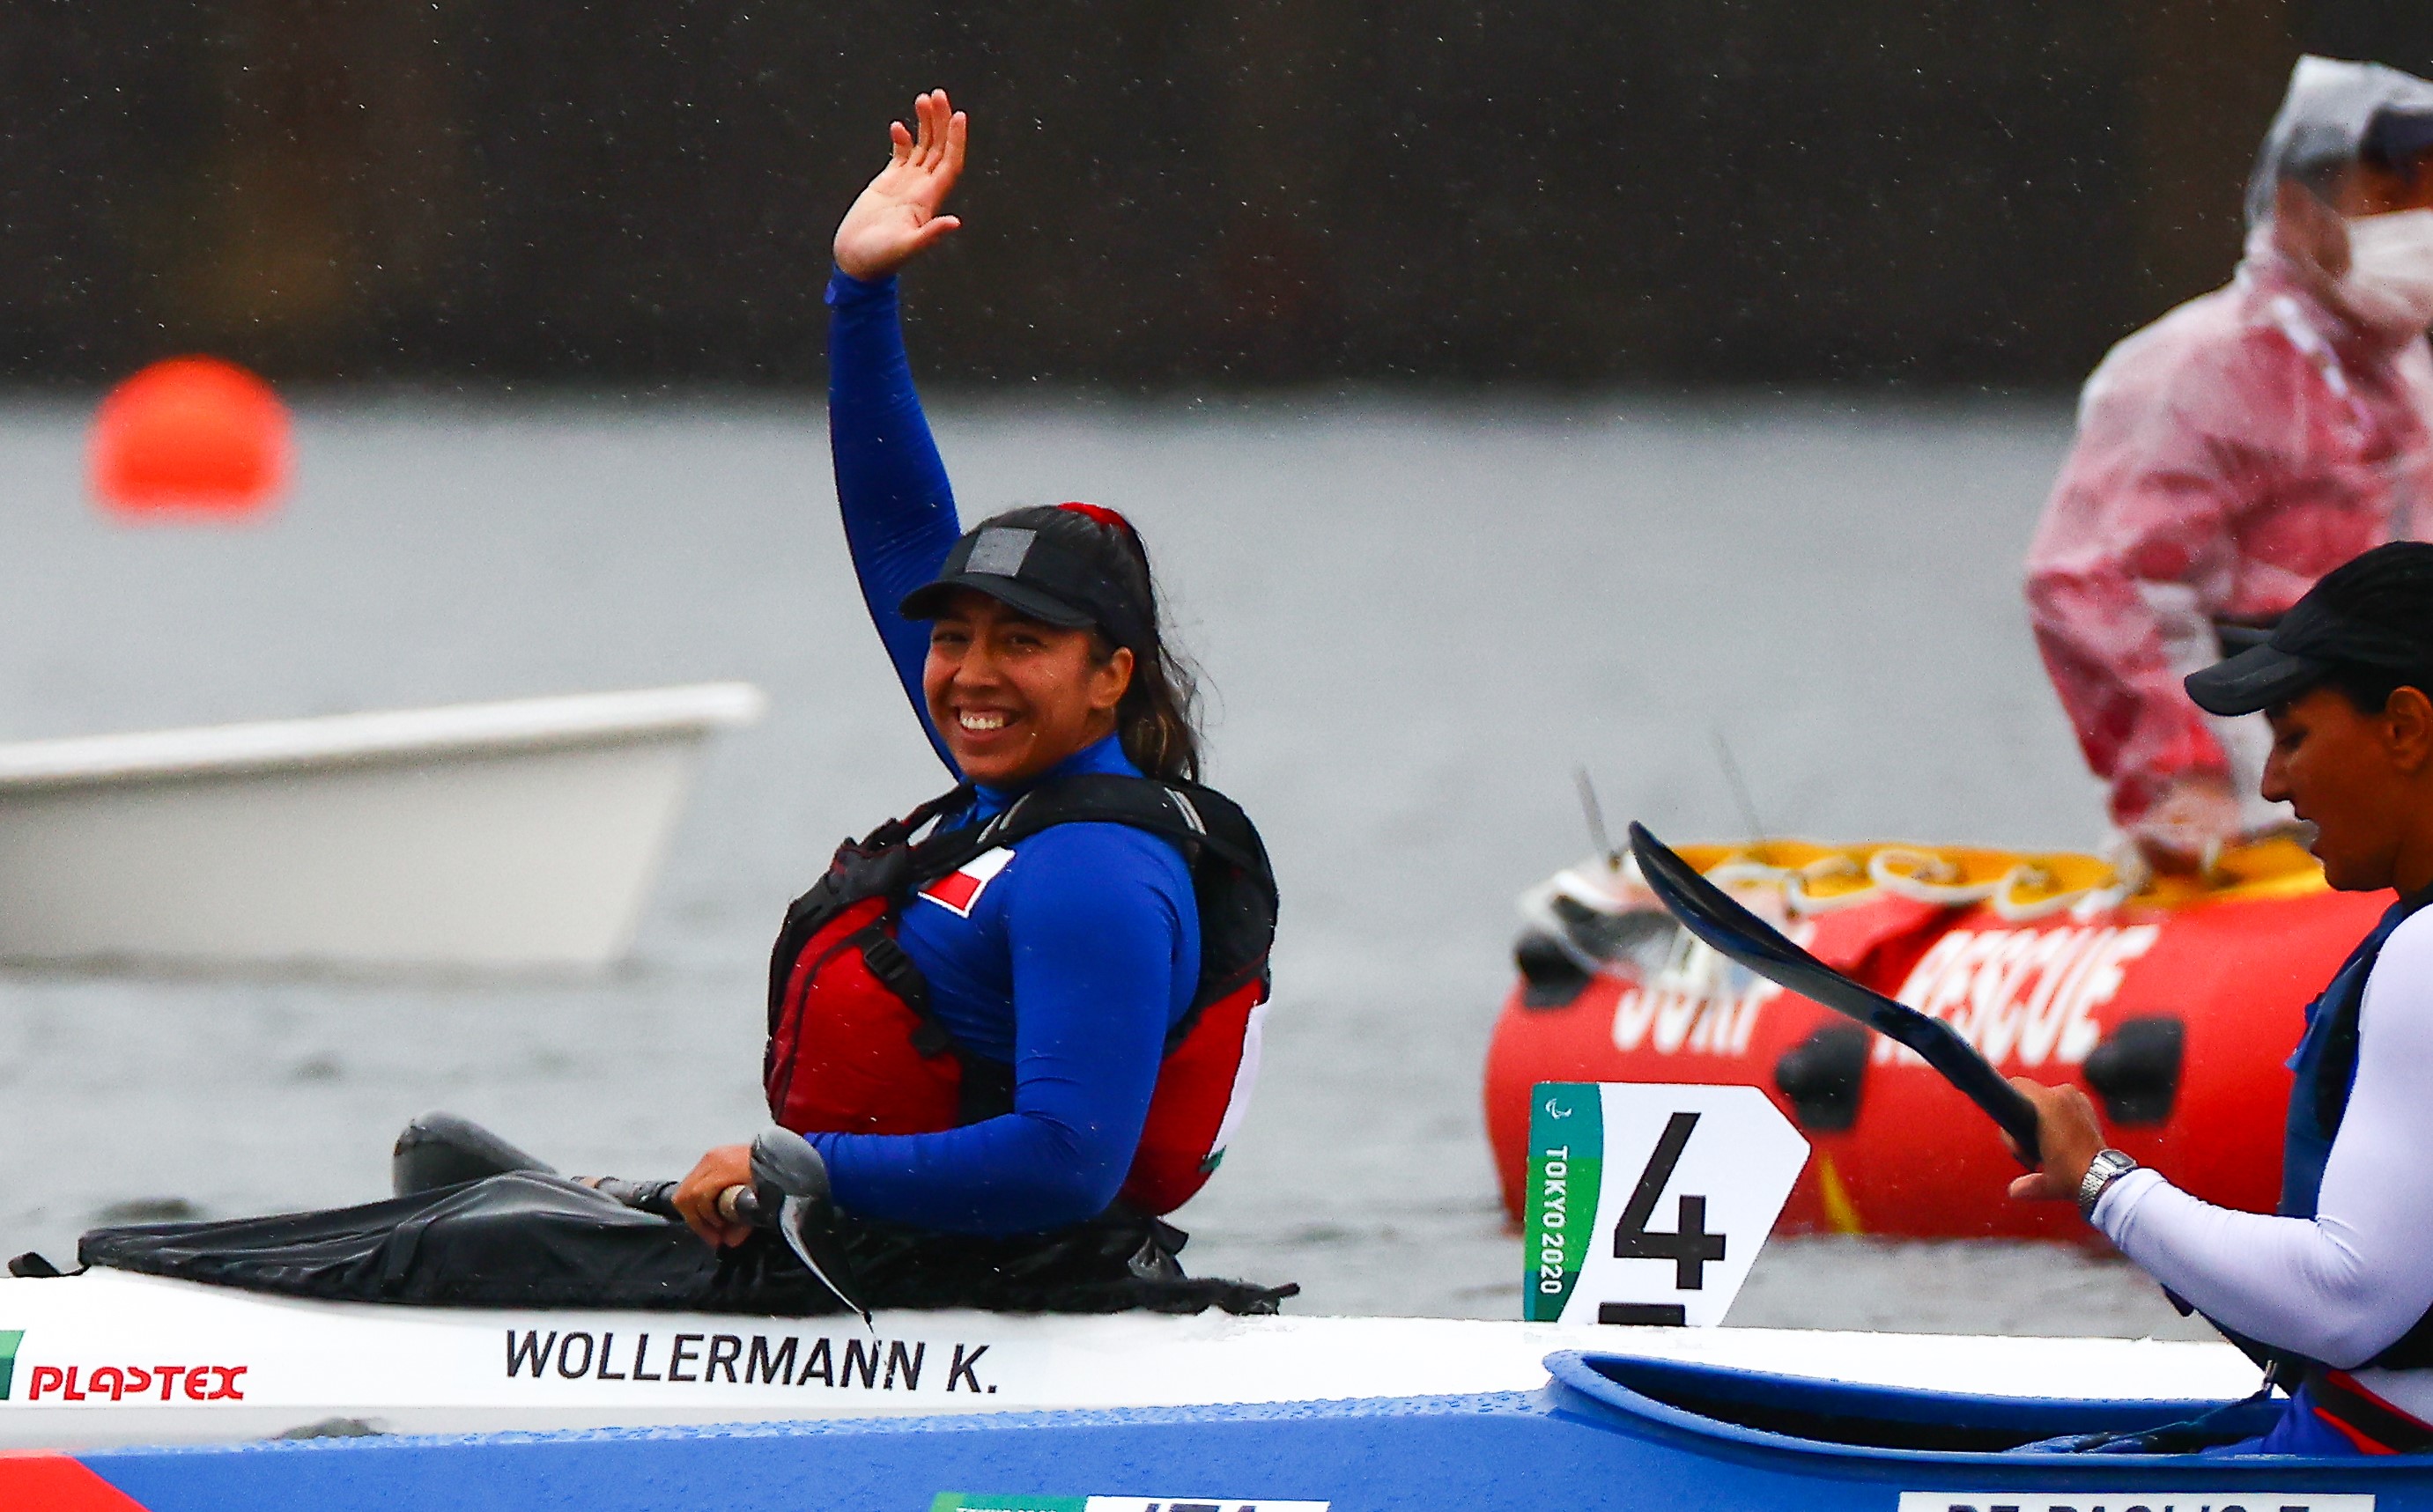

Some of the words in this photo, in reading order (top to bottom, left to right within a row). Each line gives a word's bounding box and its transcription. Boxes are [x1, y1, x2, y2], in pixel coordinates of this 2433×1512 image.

[1542, 1145, 1569, 1229] TOKYO
[1614, 1111, 1727, 1290] 4
[1540, 1237, 1565, 1294] 2020
[28, 1365, 248, 1400] PLASTEX
[506, 1330, 925, 1390] WOLLERMANN
[946, 1344, 997, 1394] K.
